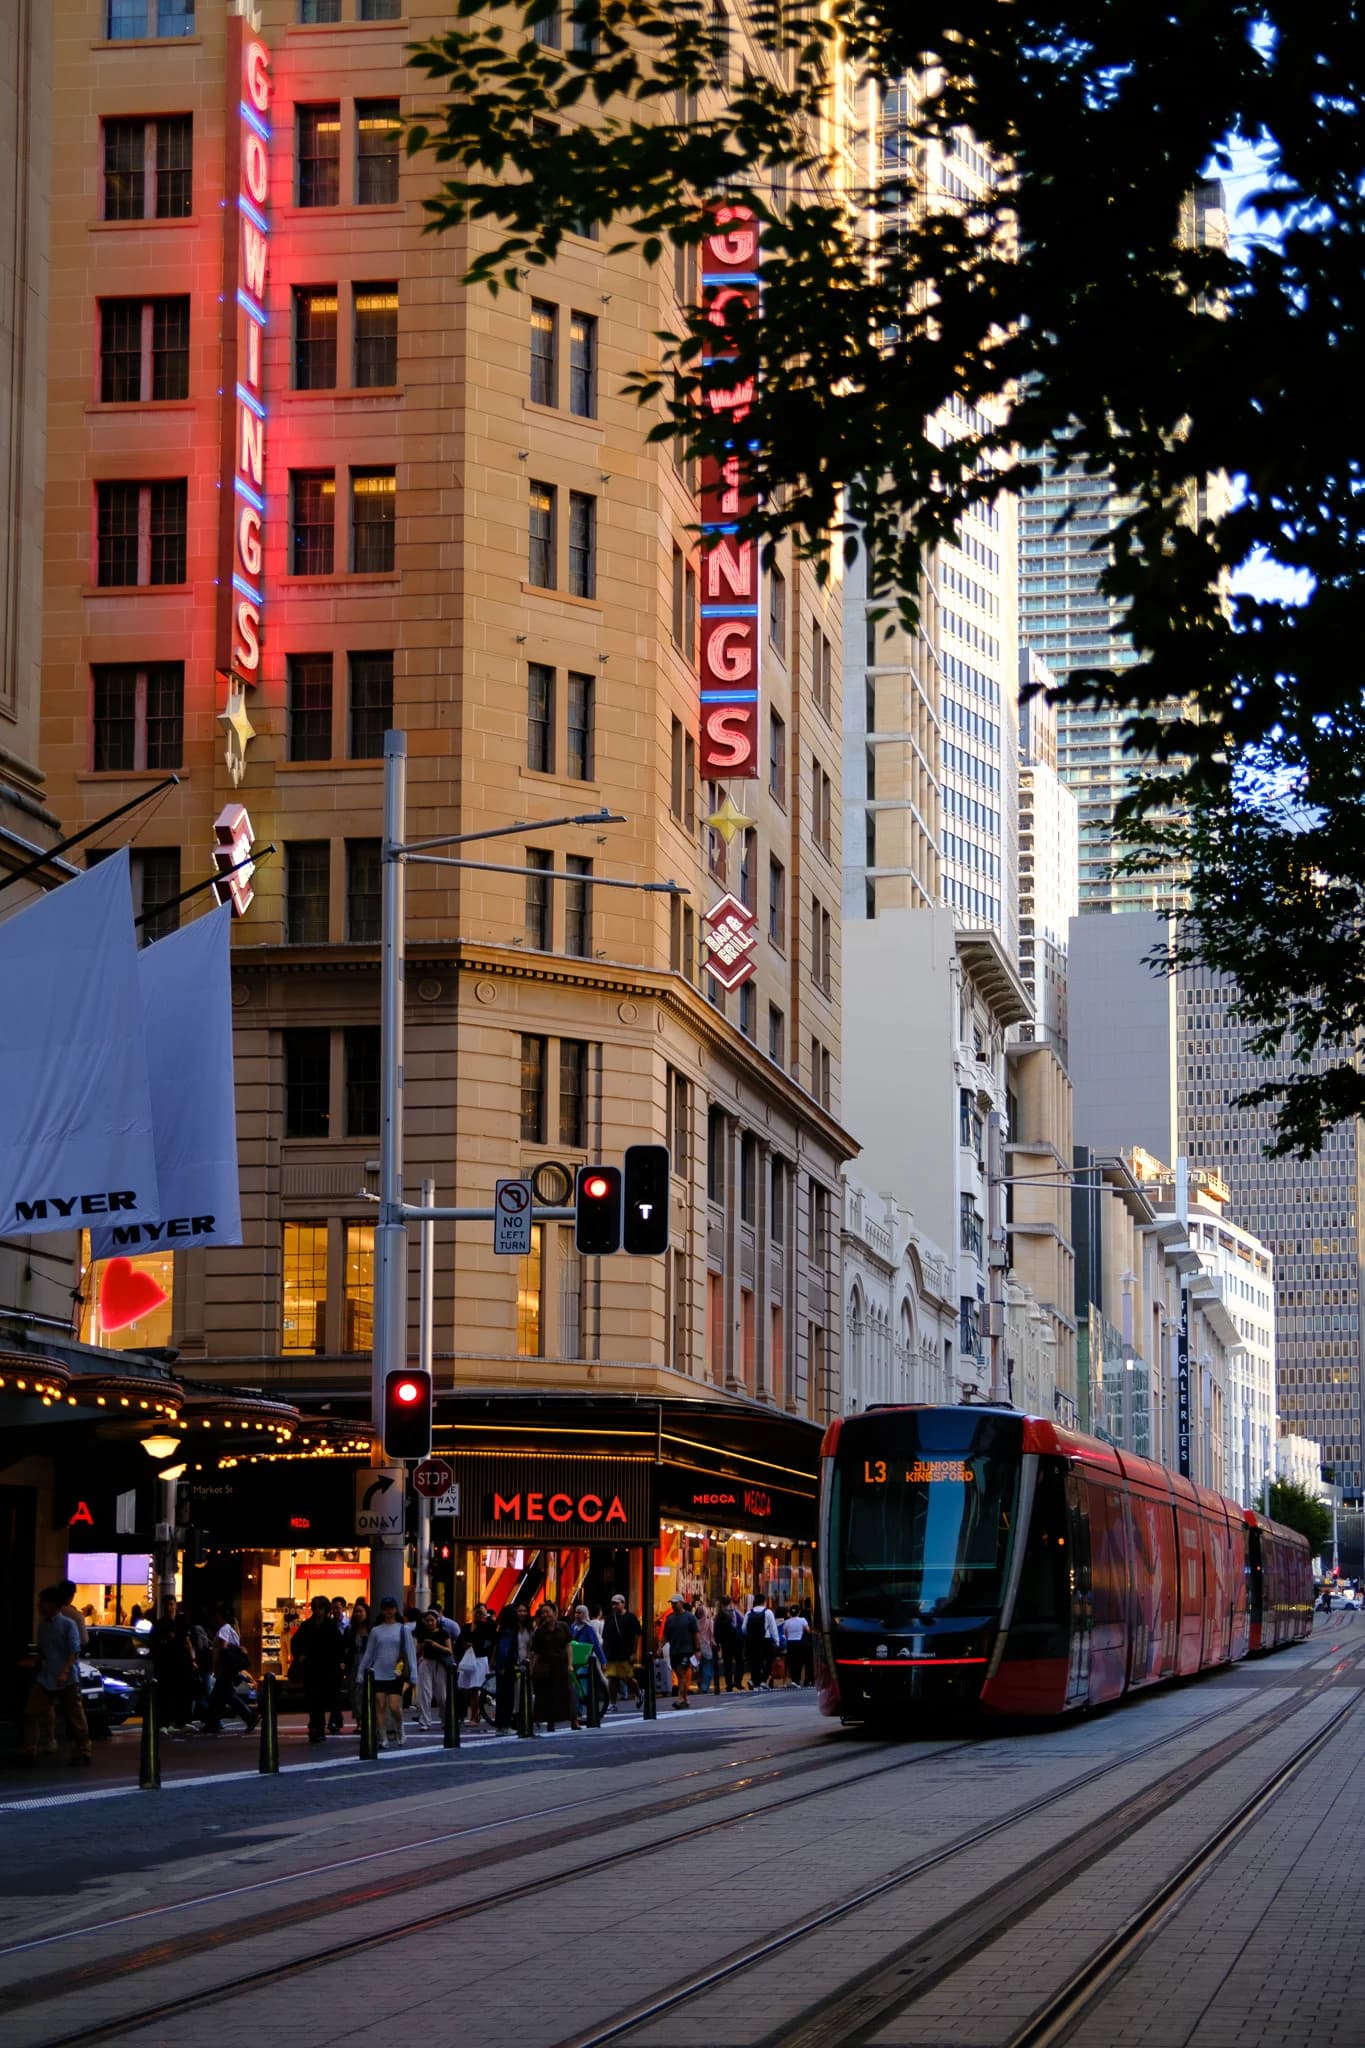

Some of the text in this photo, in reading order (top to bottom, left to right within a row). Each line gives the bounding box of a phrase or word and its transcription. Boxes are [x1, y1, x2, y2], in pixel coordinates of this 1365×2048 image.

[236, 41, 270, 670] GOWINGS
[704, 923, 734, 953] BAR
[716, 930, 754, 966] GRILL
[15, 1190, 137, 1221] MYER
[112, 1215, 216, 1245] MYER
[503, 1216, 523, 1228] NO
[500, 1231, 524, 1240] LEFT
[500, 1241, 526, 1250] TURN
[1179, 1300, 1188, 1337] THE
[1179, 1353, 1188, 1461] GALERIES
[417, 1471, 449, 1486] STOP
[864, 1460, 966, 1483] L3 JUNIORS
[905, 1471, 974, 1482] KINGSFORD
[437, 1496, 457, 1505] WAY
[493, 1492, 628, 1523] MECCA
[692, 1492, 736, 1505] MECCA
[358, 1515, 398, 1529] ONLY
